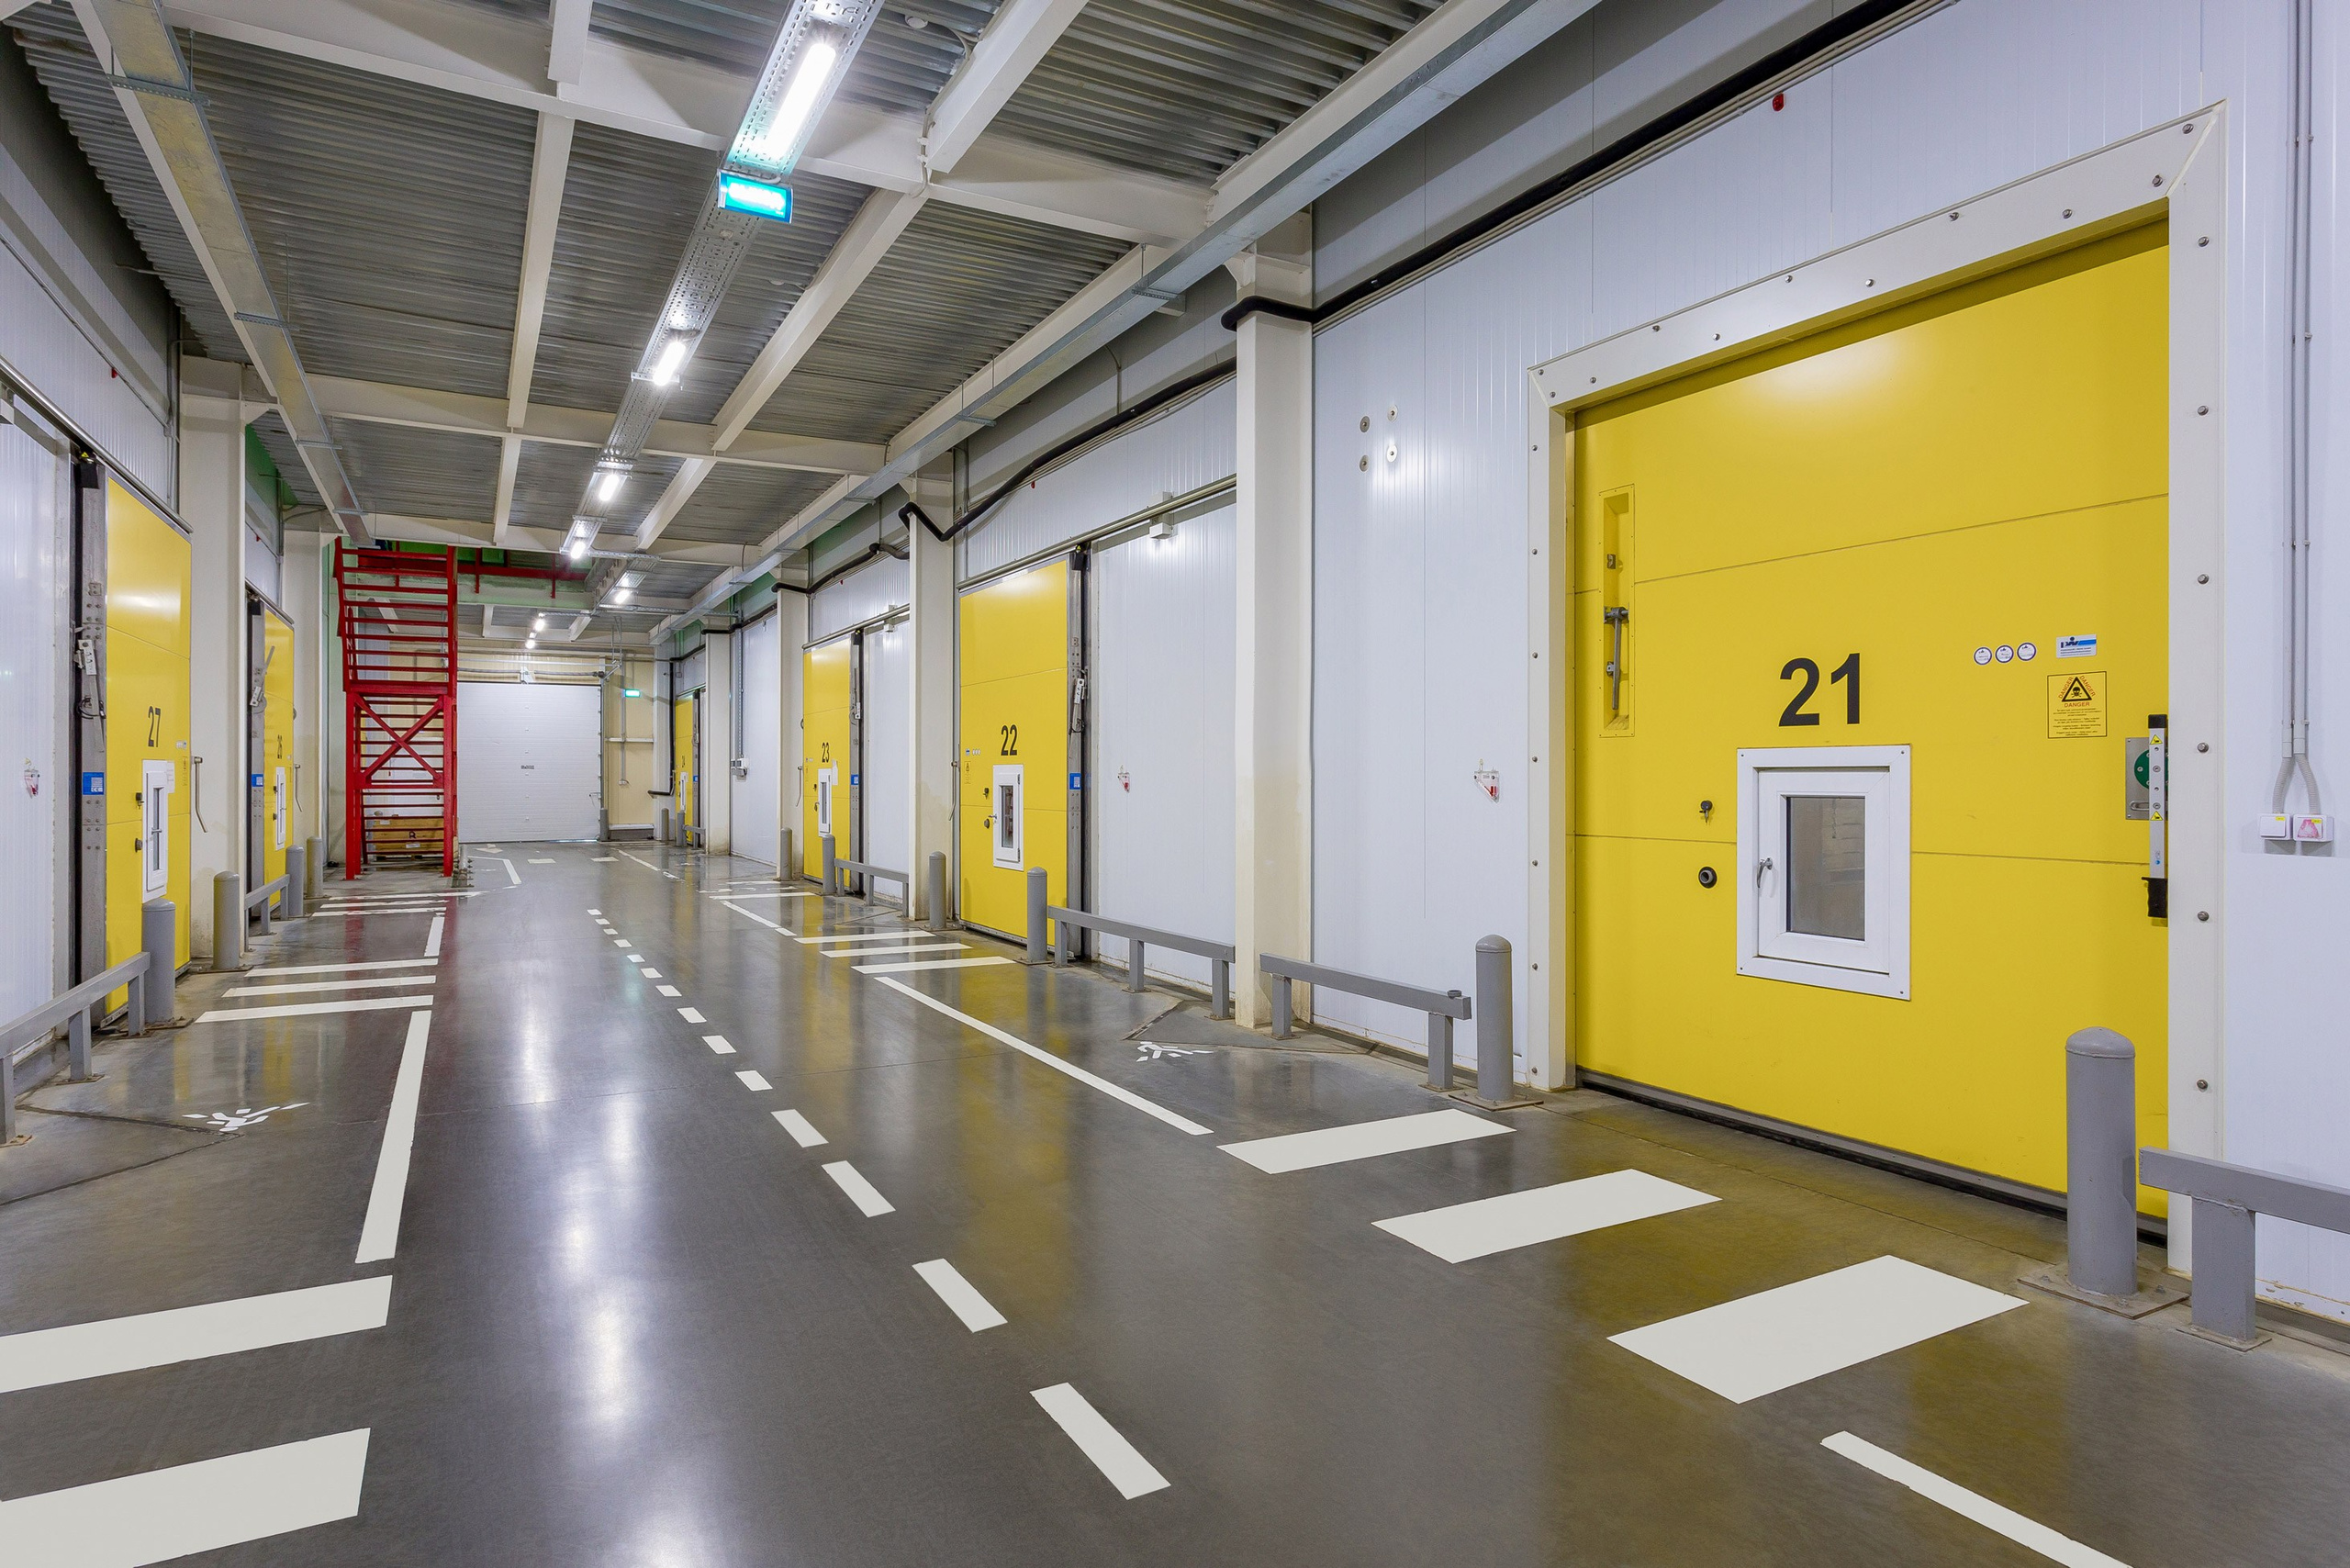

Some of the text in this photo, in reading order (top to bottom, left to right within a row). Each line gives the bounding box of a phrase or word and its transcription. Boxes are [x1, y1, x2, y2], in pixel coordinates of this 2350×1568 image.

[1778, 653, 1861, 727] 21
[2058, 676, 2074, 700] DANGER
[2079, 675, 2096, 697] DANGER
[148, 705, 162, 748] 27
[1001, 724, 1018, 756] 22
[821, 742, 830, 763] 23
